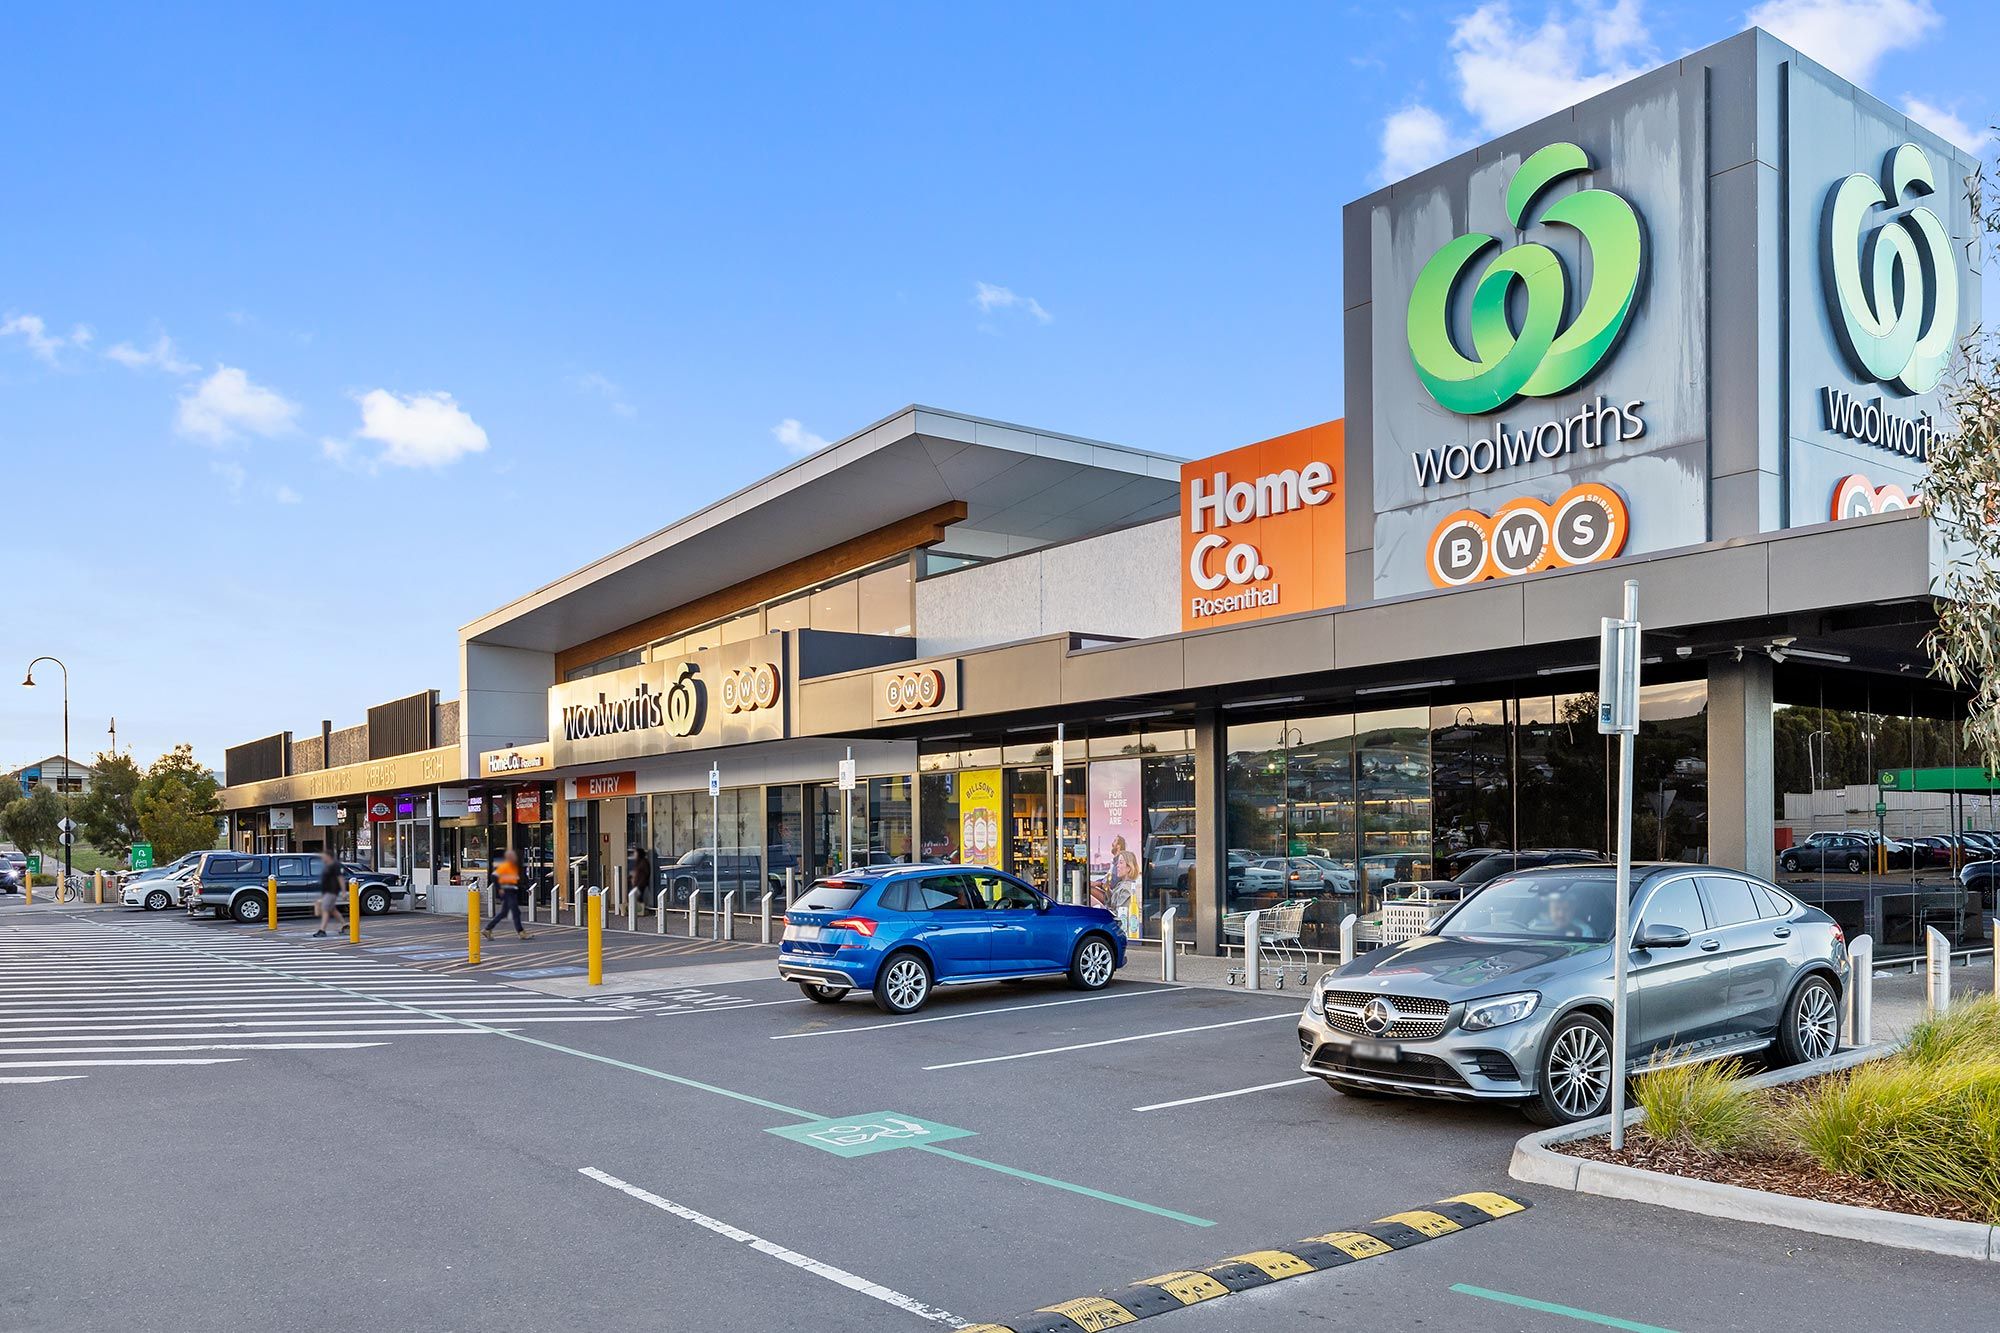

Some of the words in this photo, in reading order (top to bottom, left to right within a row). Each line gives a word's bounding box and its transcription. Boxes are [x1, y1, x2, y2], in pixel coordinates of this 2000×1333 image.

[1822, 385, 1950, 460] Woolworth
[1190, 461, 1334, 534] Home
[1586, 494, 1615, 520] SPIRITS
[1467, 521, 1487, 541] BEER
[1190, 533, 1271, 591] Co.
[1527, 543, 1548, 571] WINE
[1191, 582, 1281, 619] Rosenthal
[365, 763, 397, 788] KEBABS
[420, 753, 445, 781] TECH
[589, 776, 620, 795] ENTRY
[965, 781, 996, 799] BILLSON'S
[1108, 790, 1123, 799] FOR
[1103, 798, 1128, 808] WHERE
[1108, 807, 1123, 817] YOU
[1108, 816, 1123, 825] ARE
